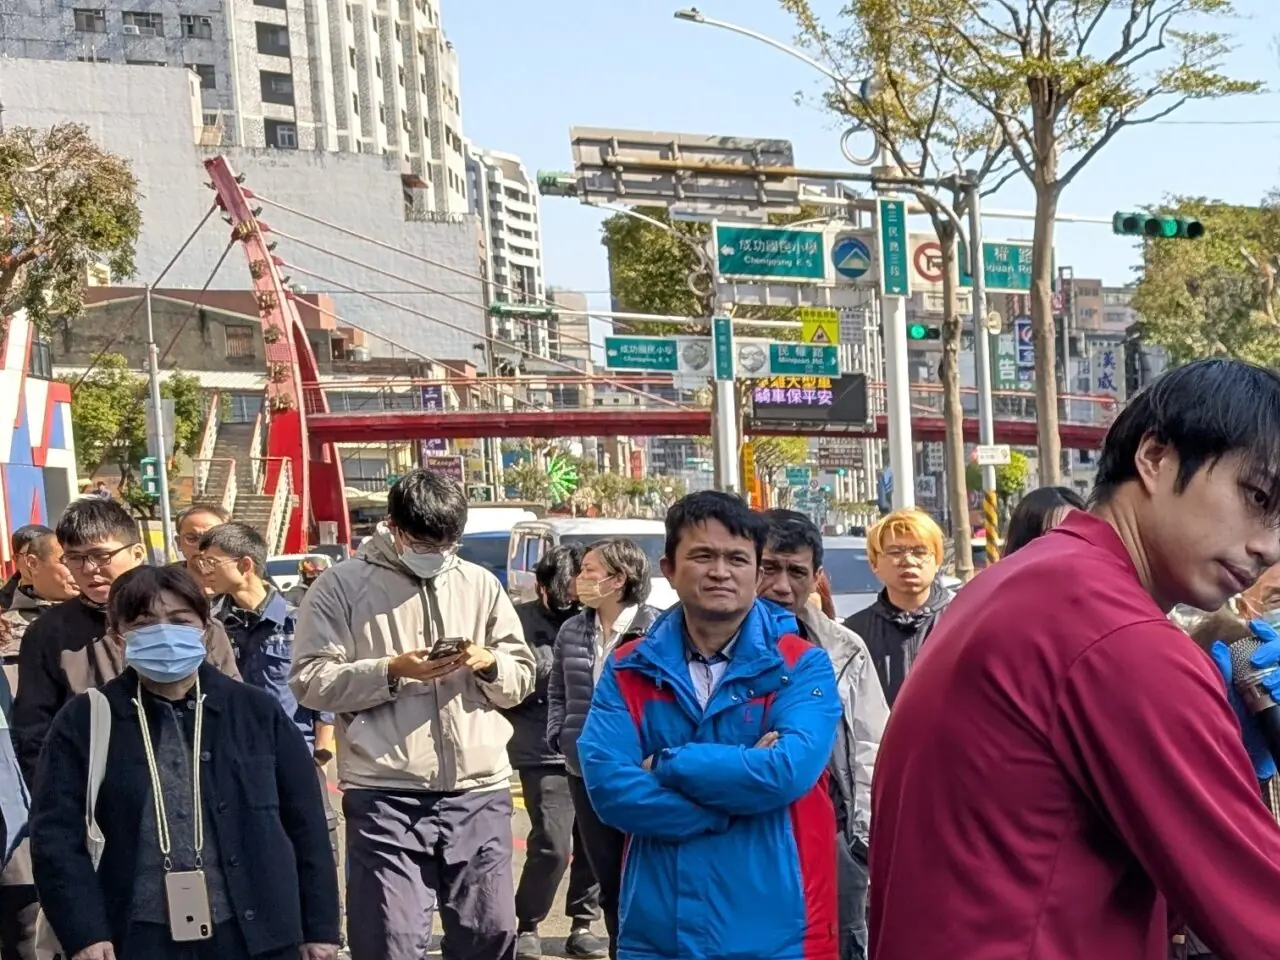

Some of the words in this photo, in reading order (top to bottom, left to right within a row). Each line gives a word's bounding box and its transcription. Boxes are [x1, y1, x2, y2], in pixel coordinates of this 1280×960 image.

[994, 247, 1032, 263] 權路
[755, 388, 833, 405] 騎車保平安
